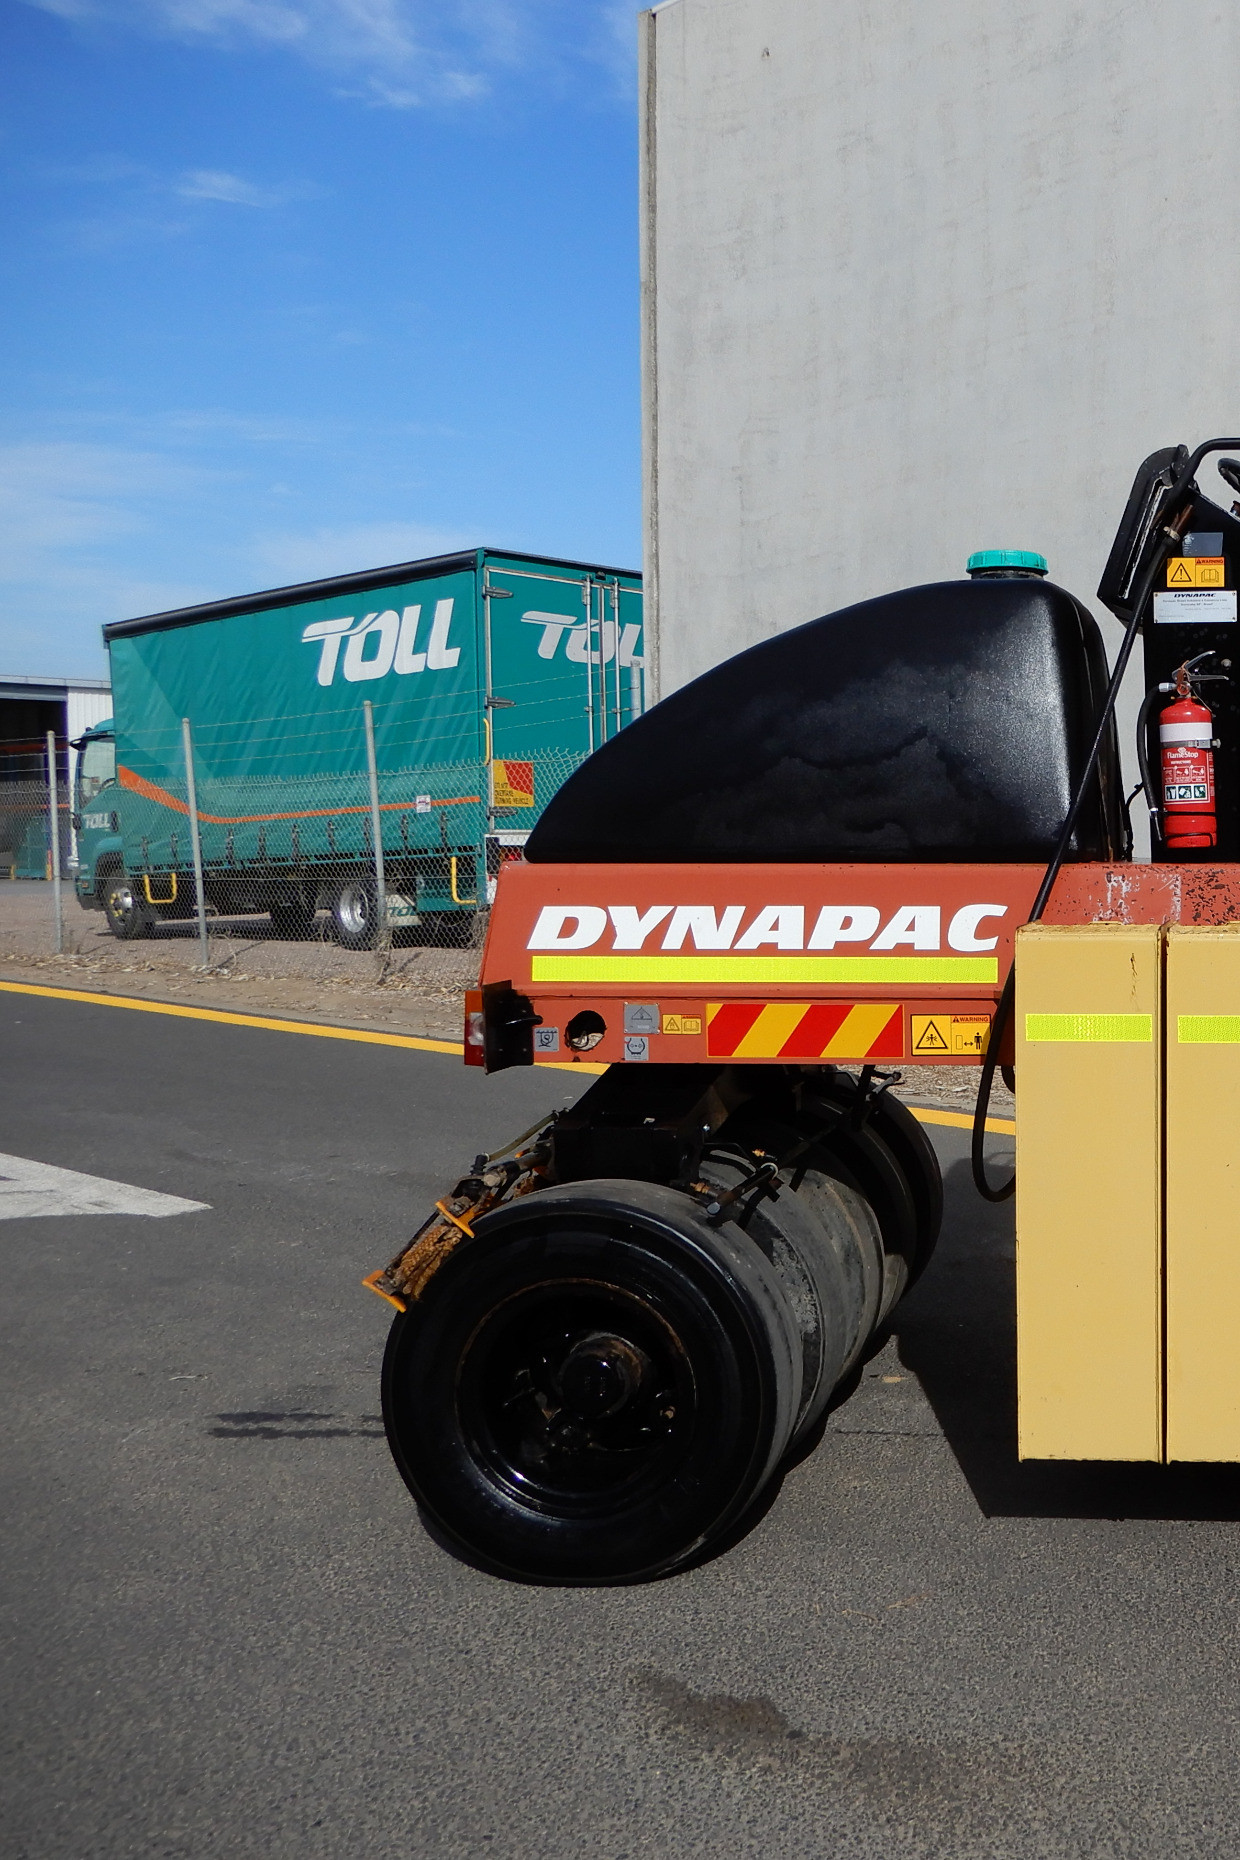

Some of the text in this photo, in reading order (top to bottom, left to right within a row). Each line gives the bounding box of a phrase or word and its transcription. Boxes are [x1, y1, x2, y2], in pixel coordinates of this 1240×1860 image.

[302, 598, 461, 687] TOLL
[520, 611, 645, 668] TOL
[83, 813, 111, 829] TOLL
[527, 904, 1008, 952] DYNAPAC
